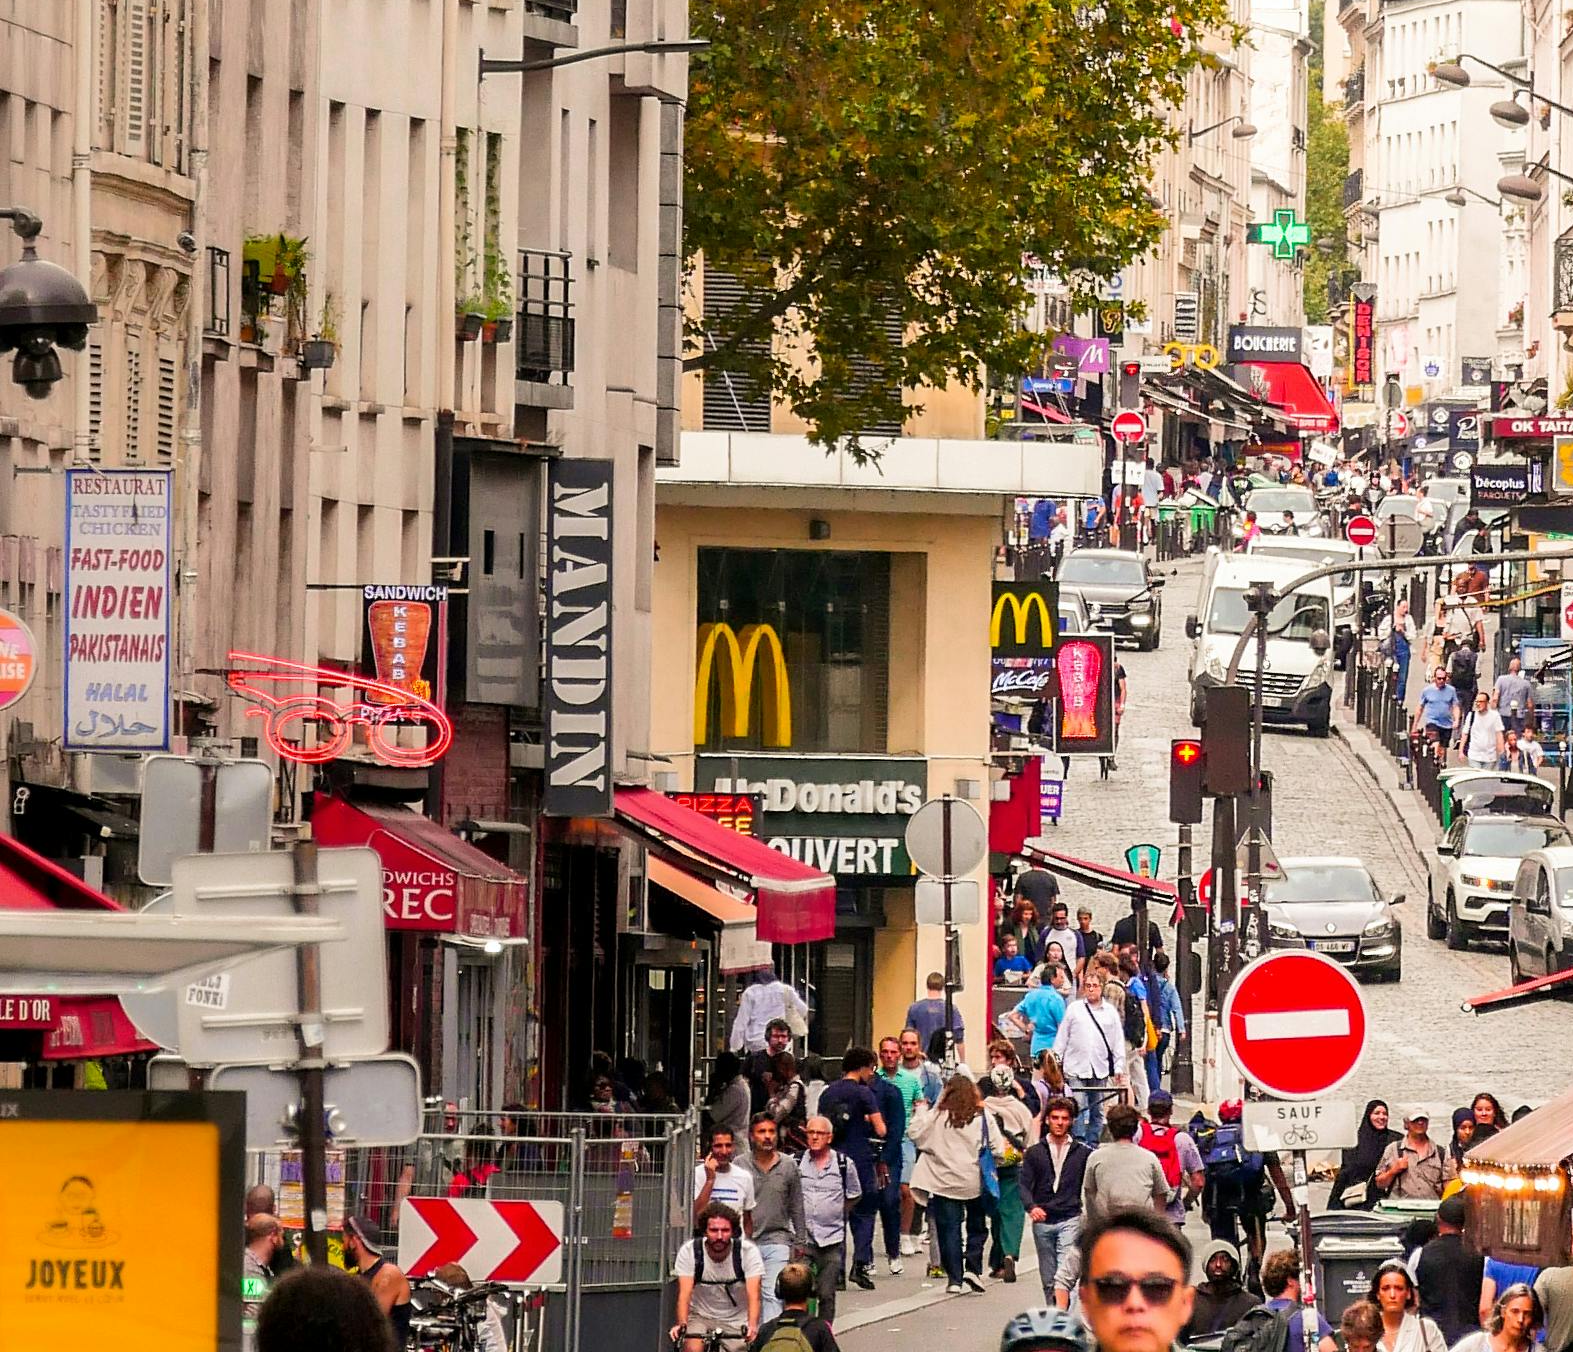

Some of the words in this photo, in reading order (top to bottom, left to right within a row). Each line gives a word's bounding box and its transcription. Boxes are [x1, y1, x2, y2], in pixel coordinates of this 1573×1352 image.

[1233, 335, 1296, 352] BOUCHERIE
[1511, 420, 1534, 432] OK
[73, 478, 165, 495] RESTAURAT
[79, 522, 162, 536] CHICKEN
[71, 548, 164, 572] FAST-FOOD
[71, 585, 164, 620] INDIEN
[364, 586, 447, 600] SANDWICH
[392, 606, 407, 680] KEBAB
[550, 482, 608, 792] MANDIN
[69, 634, 165, 663] PAKISTANAIS
[85, 682, 149, 702] HALAL
[19, 999, 51, 1021] D'OR
[1278, 1106, 1323, 1120] SAUF
[25, 1259, 125, 1289] JOYEUX
